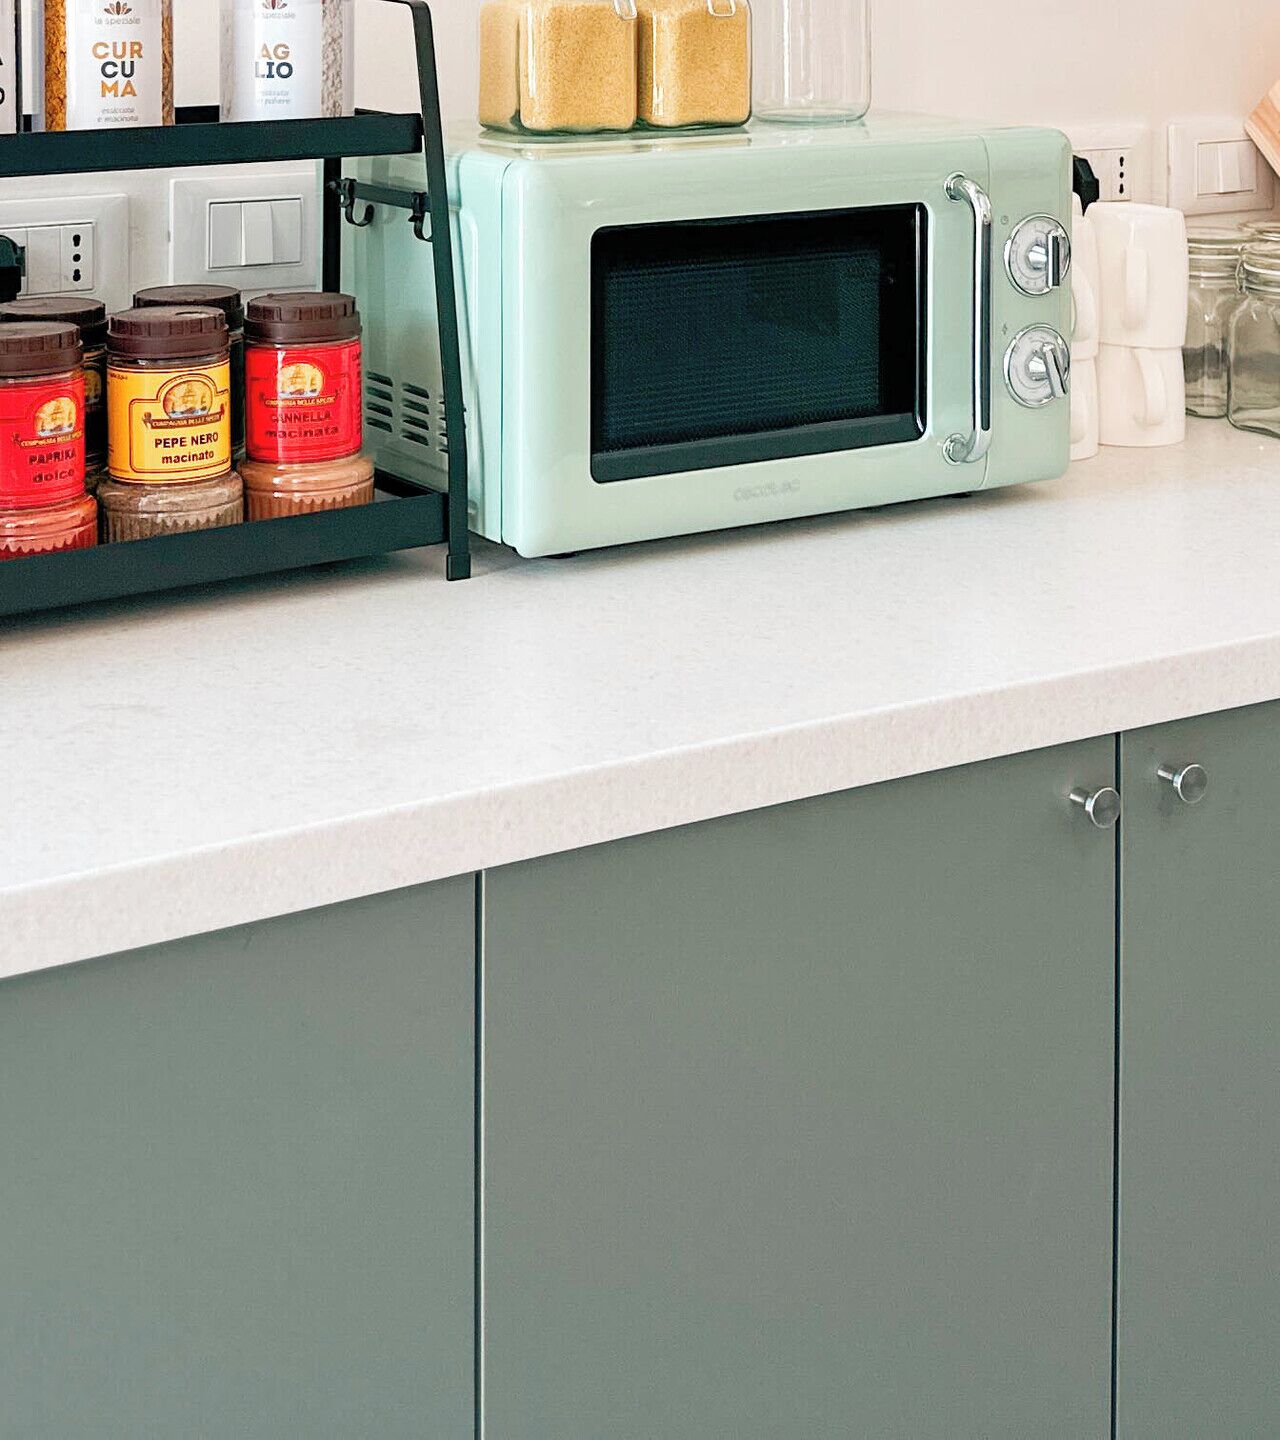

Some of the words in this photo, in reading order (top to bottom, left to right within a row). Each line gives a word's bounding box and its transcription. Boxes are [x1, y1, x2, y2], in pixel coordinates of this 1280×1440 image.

[92, 41, 143, 59] CUR
[261, 43, 290, 60] AG
[101, 60, 135, 79] CU
[254, 61, 294, 79] LIO
[101, 79, 137, 98] MA
[154, 436, 188, 449] PEPE
[190, 431, 219, 447] NERO
[29, 448, 76, 465] PAPRIKA
[161, 449, 214, 464] macinato
[33, 468, 75, 483] dolce
